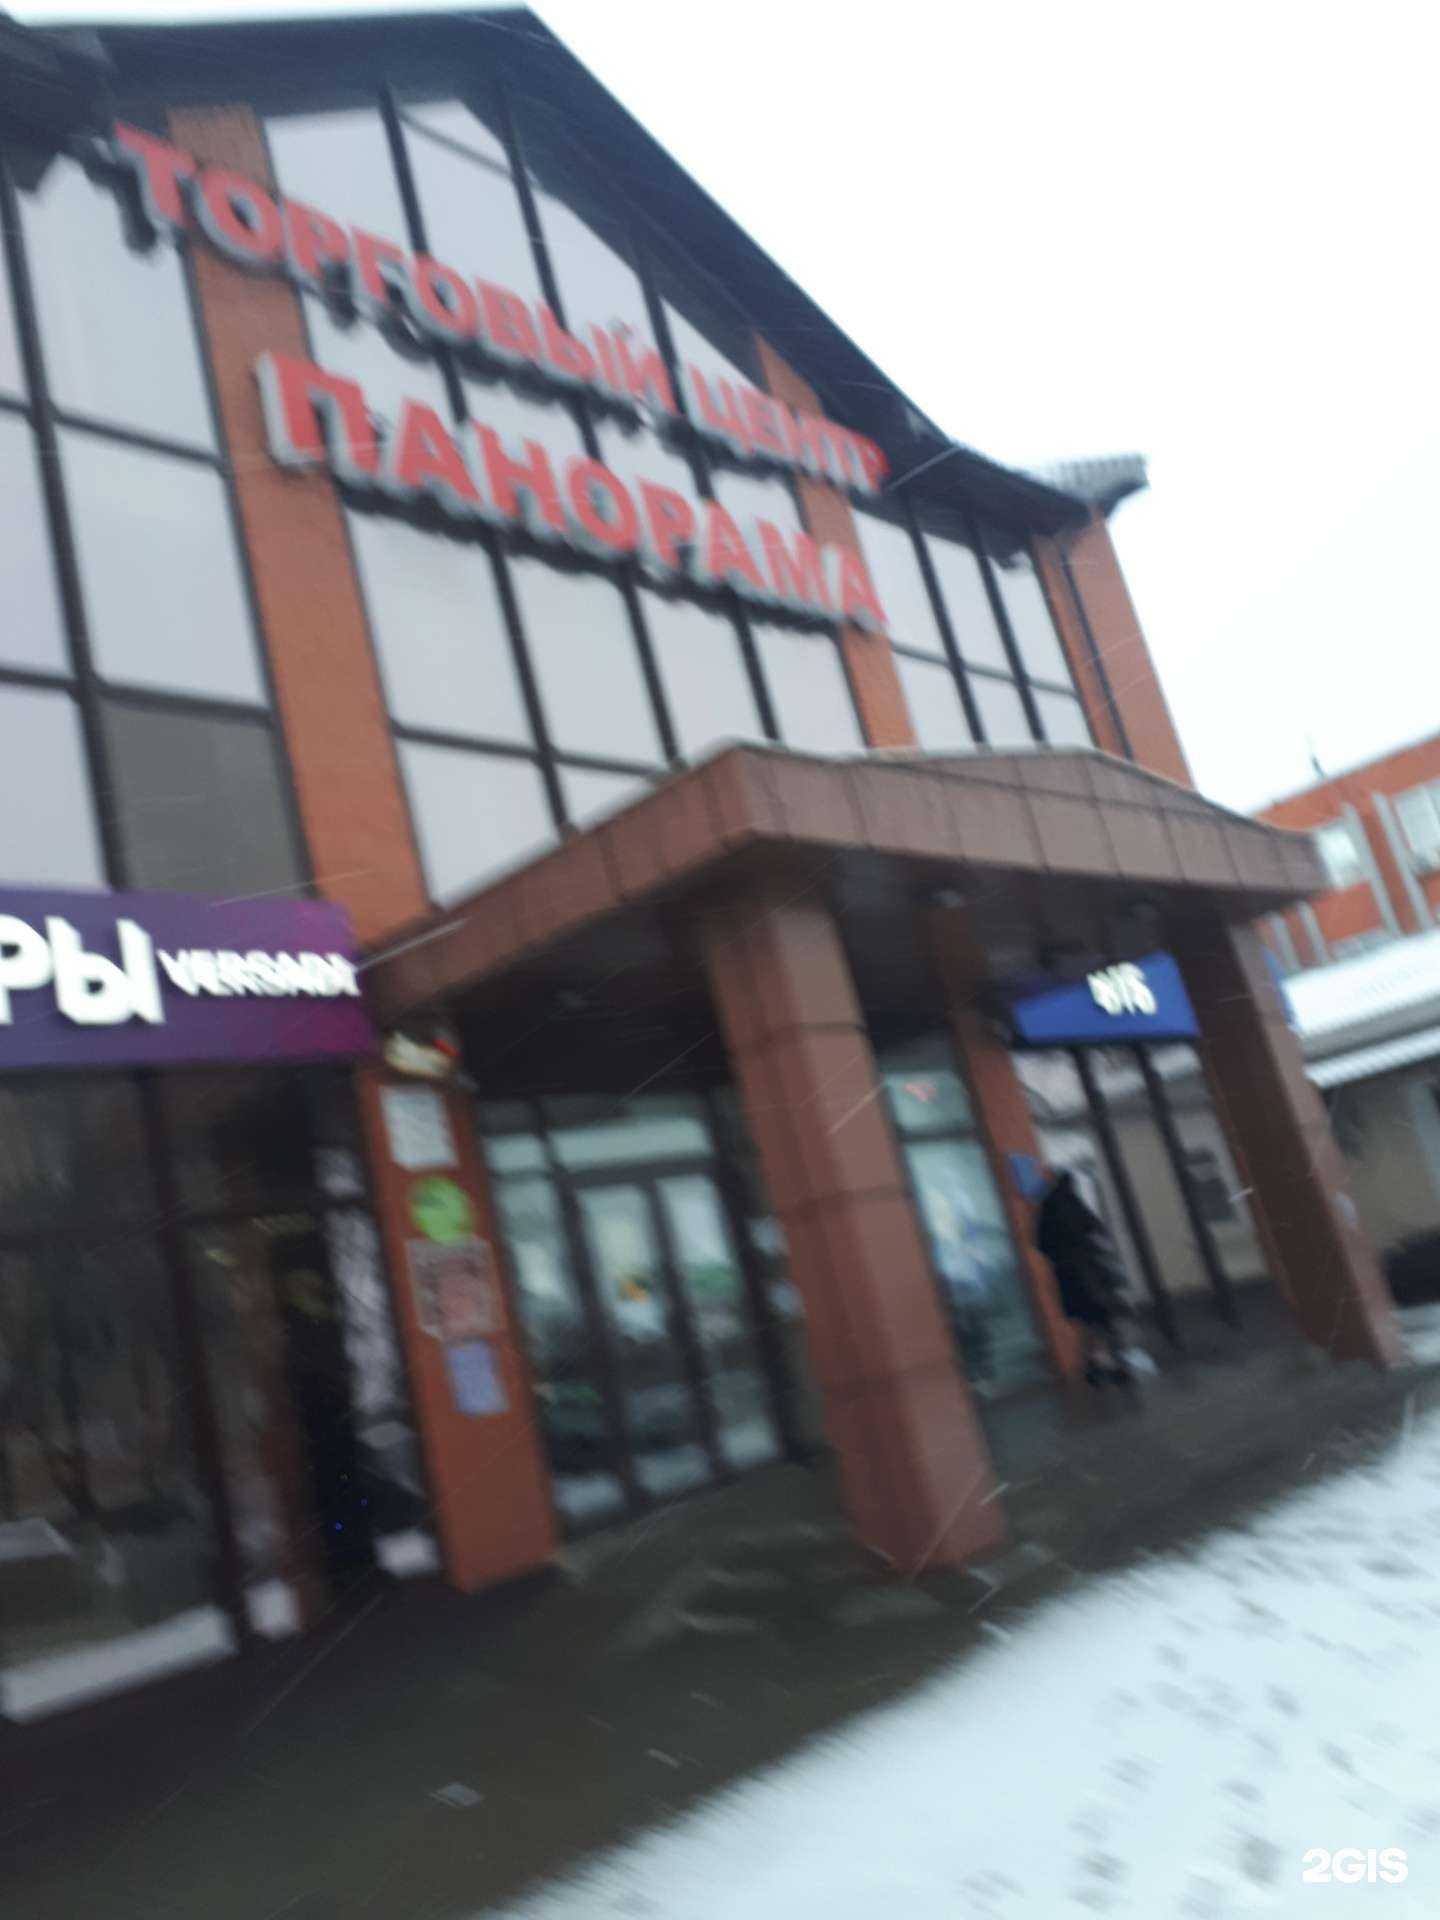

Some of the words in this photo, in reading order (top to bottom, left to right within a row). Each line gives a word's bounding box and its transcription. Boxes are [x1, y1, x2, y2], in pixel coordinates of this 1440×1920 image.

[113, 120, 678, 415] ТОРГОВЫЙ
[688, 366, 890, 494] ЦЕНТР
[260, 350, 888, 628] ПАНОРАМА
